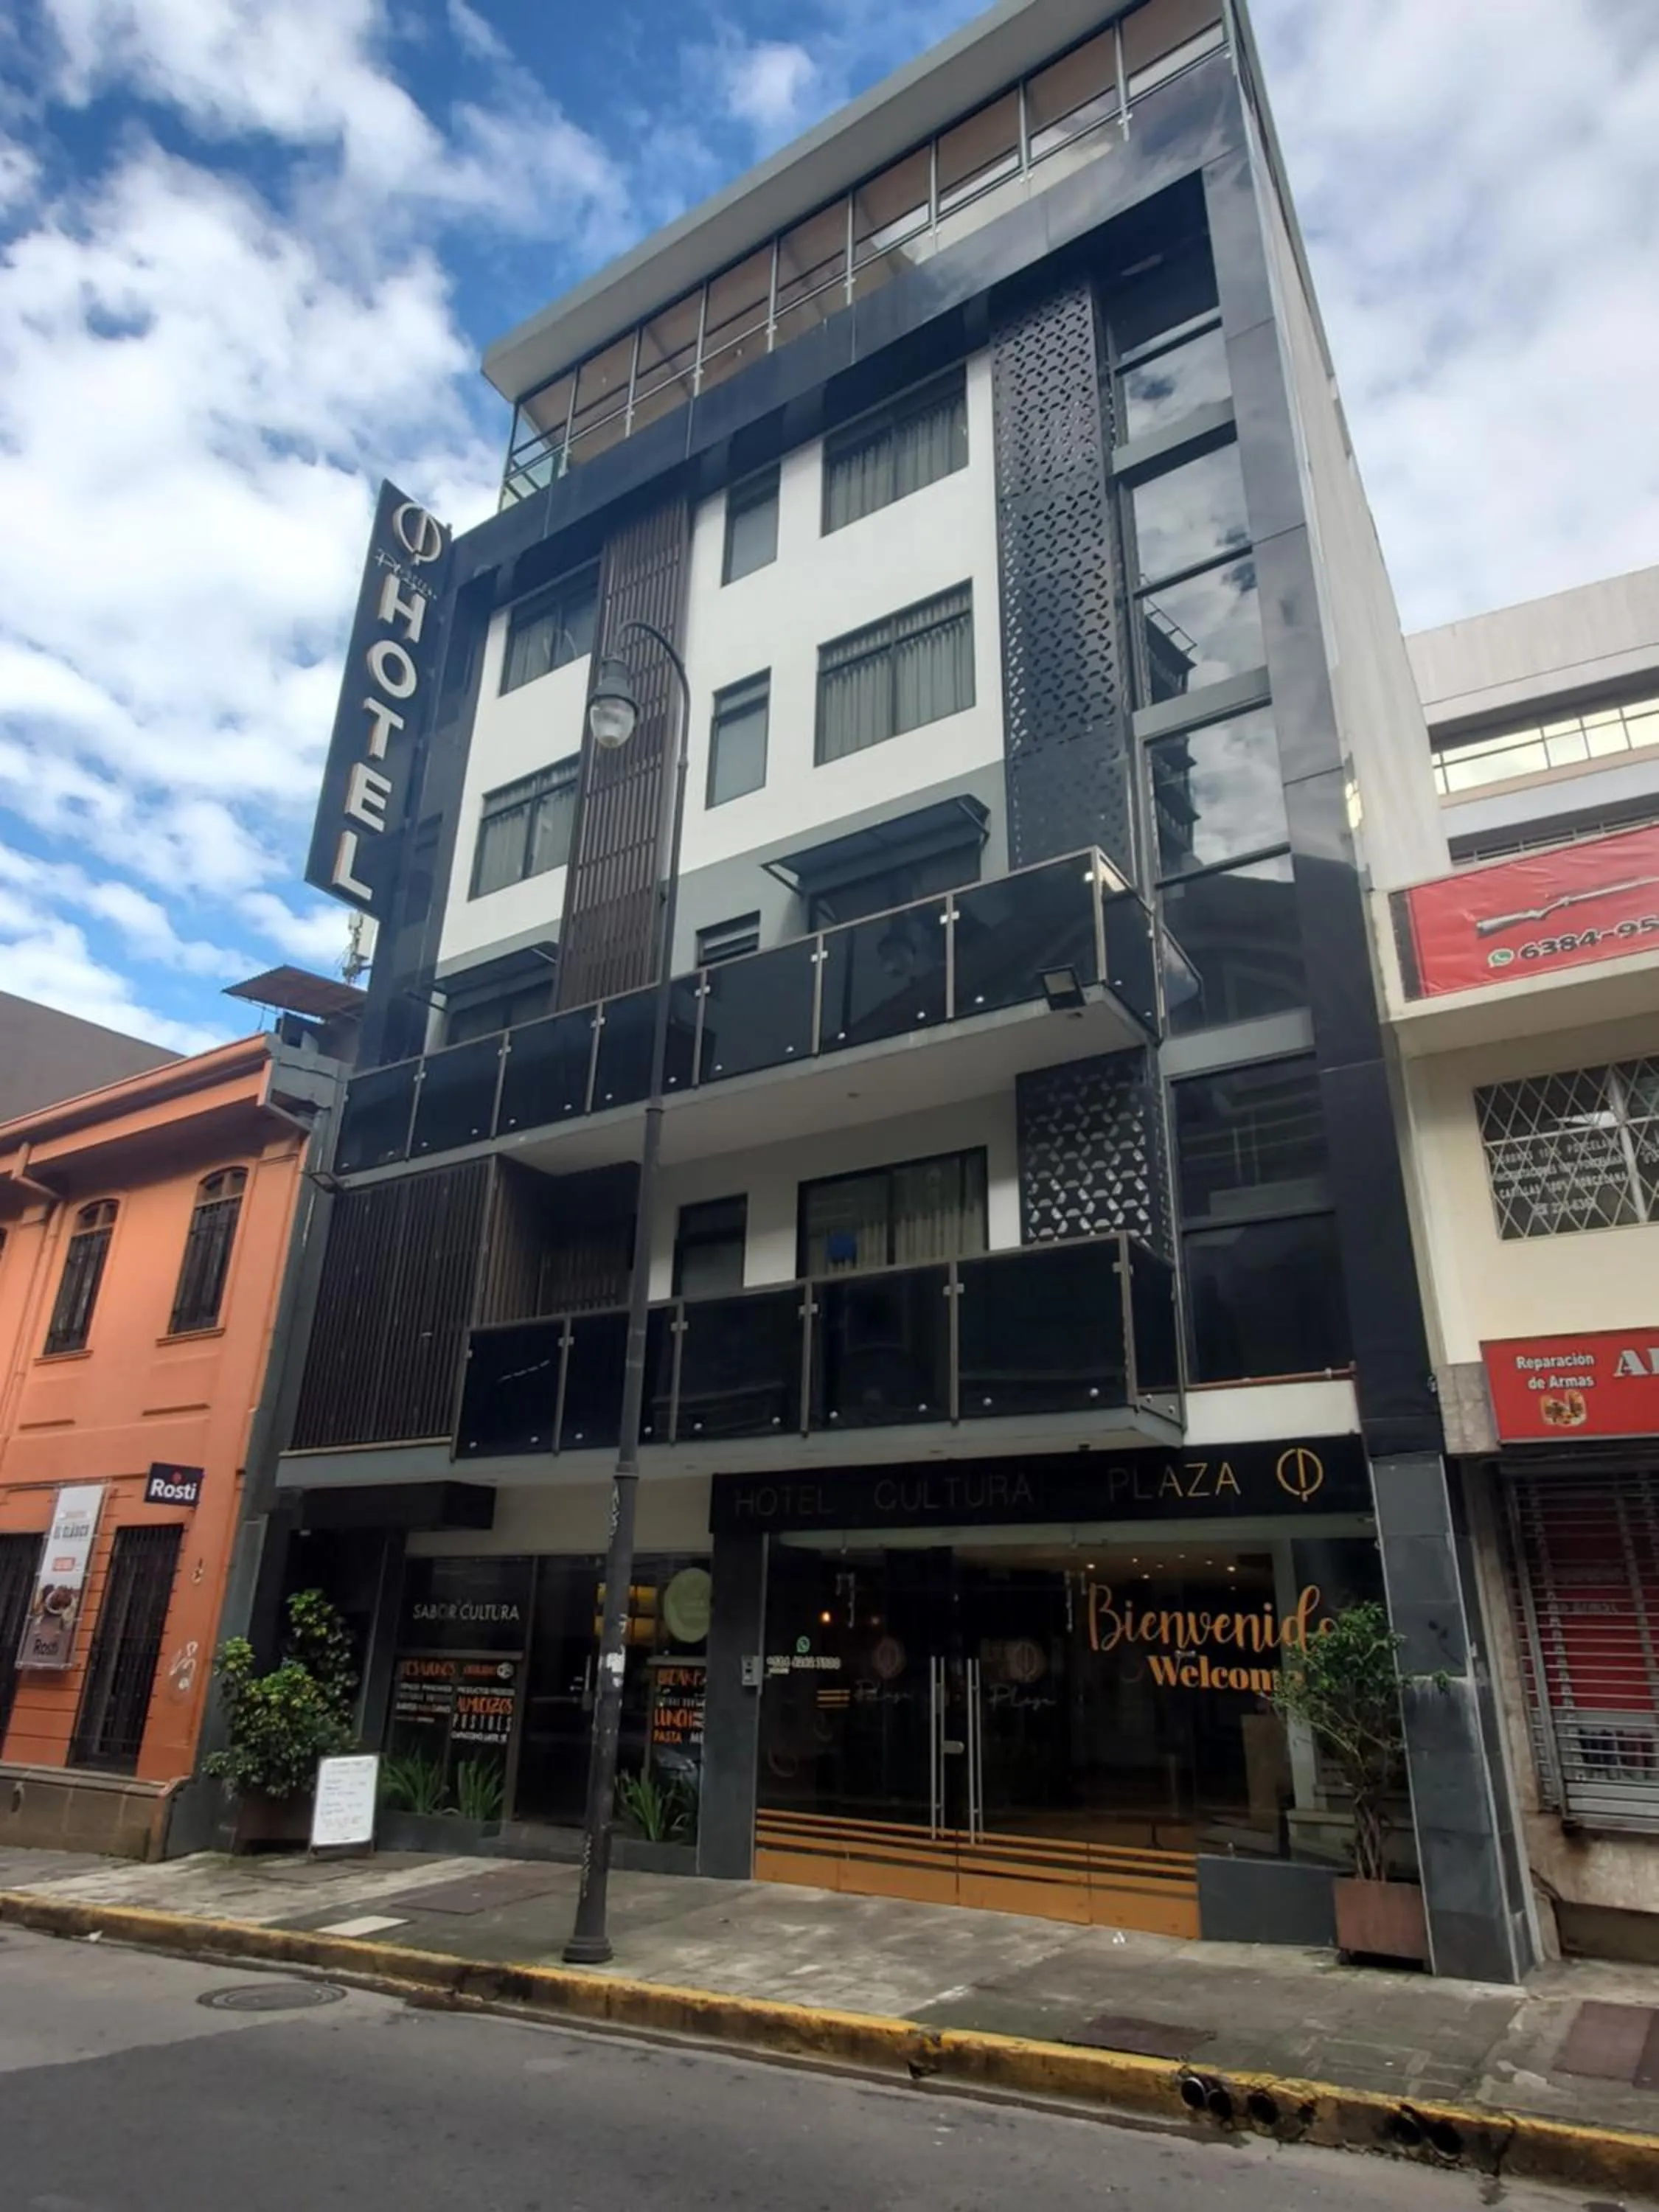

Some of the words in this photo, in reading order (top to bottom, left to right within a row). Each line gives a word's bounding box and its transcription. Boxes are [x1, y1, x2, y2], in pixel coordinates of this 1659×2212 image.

[331, 572, 426, 902] HOTEL
[1518, 914, 1659, 960] 6384-95
[1515, 1352, 1595, 1371] Reparación
[1528, 1376, 1545, 1390] de
[1548, 1374, 1594, 1389] Armas
[150, 1478, 197, 1501] Rosti
[735, 1485, 836, 1517] HOTEL
[874, 1473, 1034, 1512] CULTURA
[1107, 1461, 1242, 1501] PLAZA
[412, 1603, 456, 1621] SABOR
[459, 1603, 520, 1621] CULTURA
